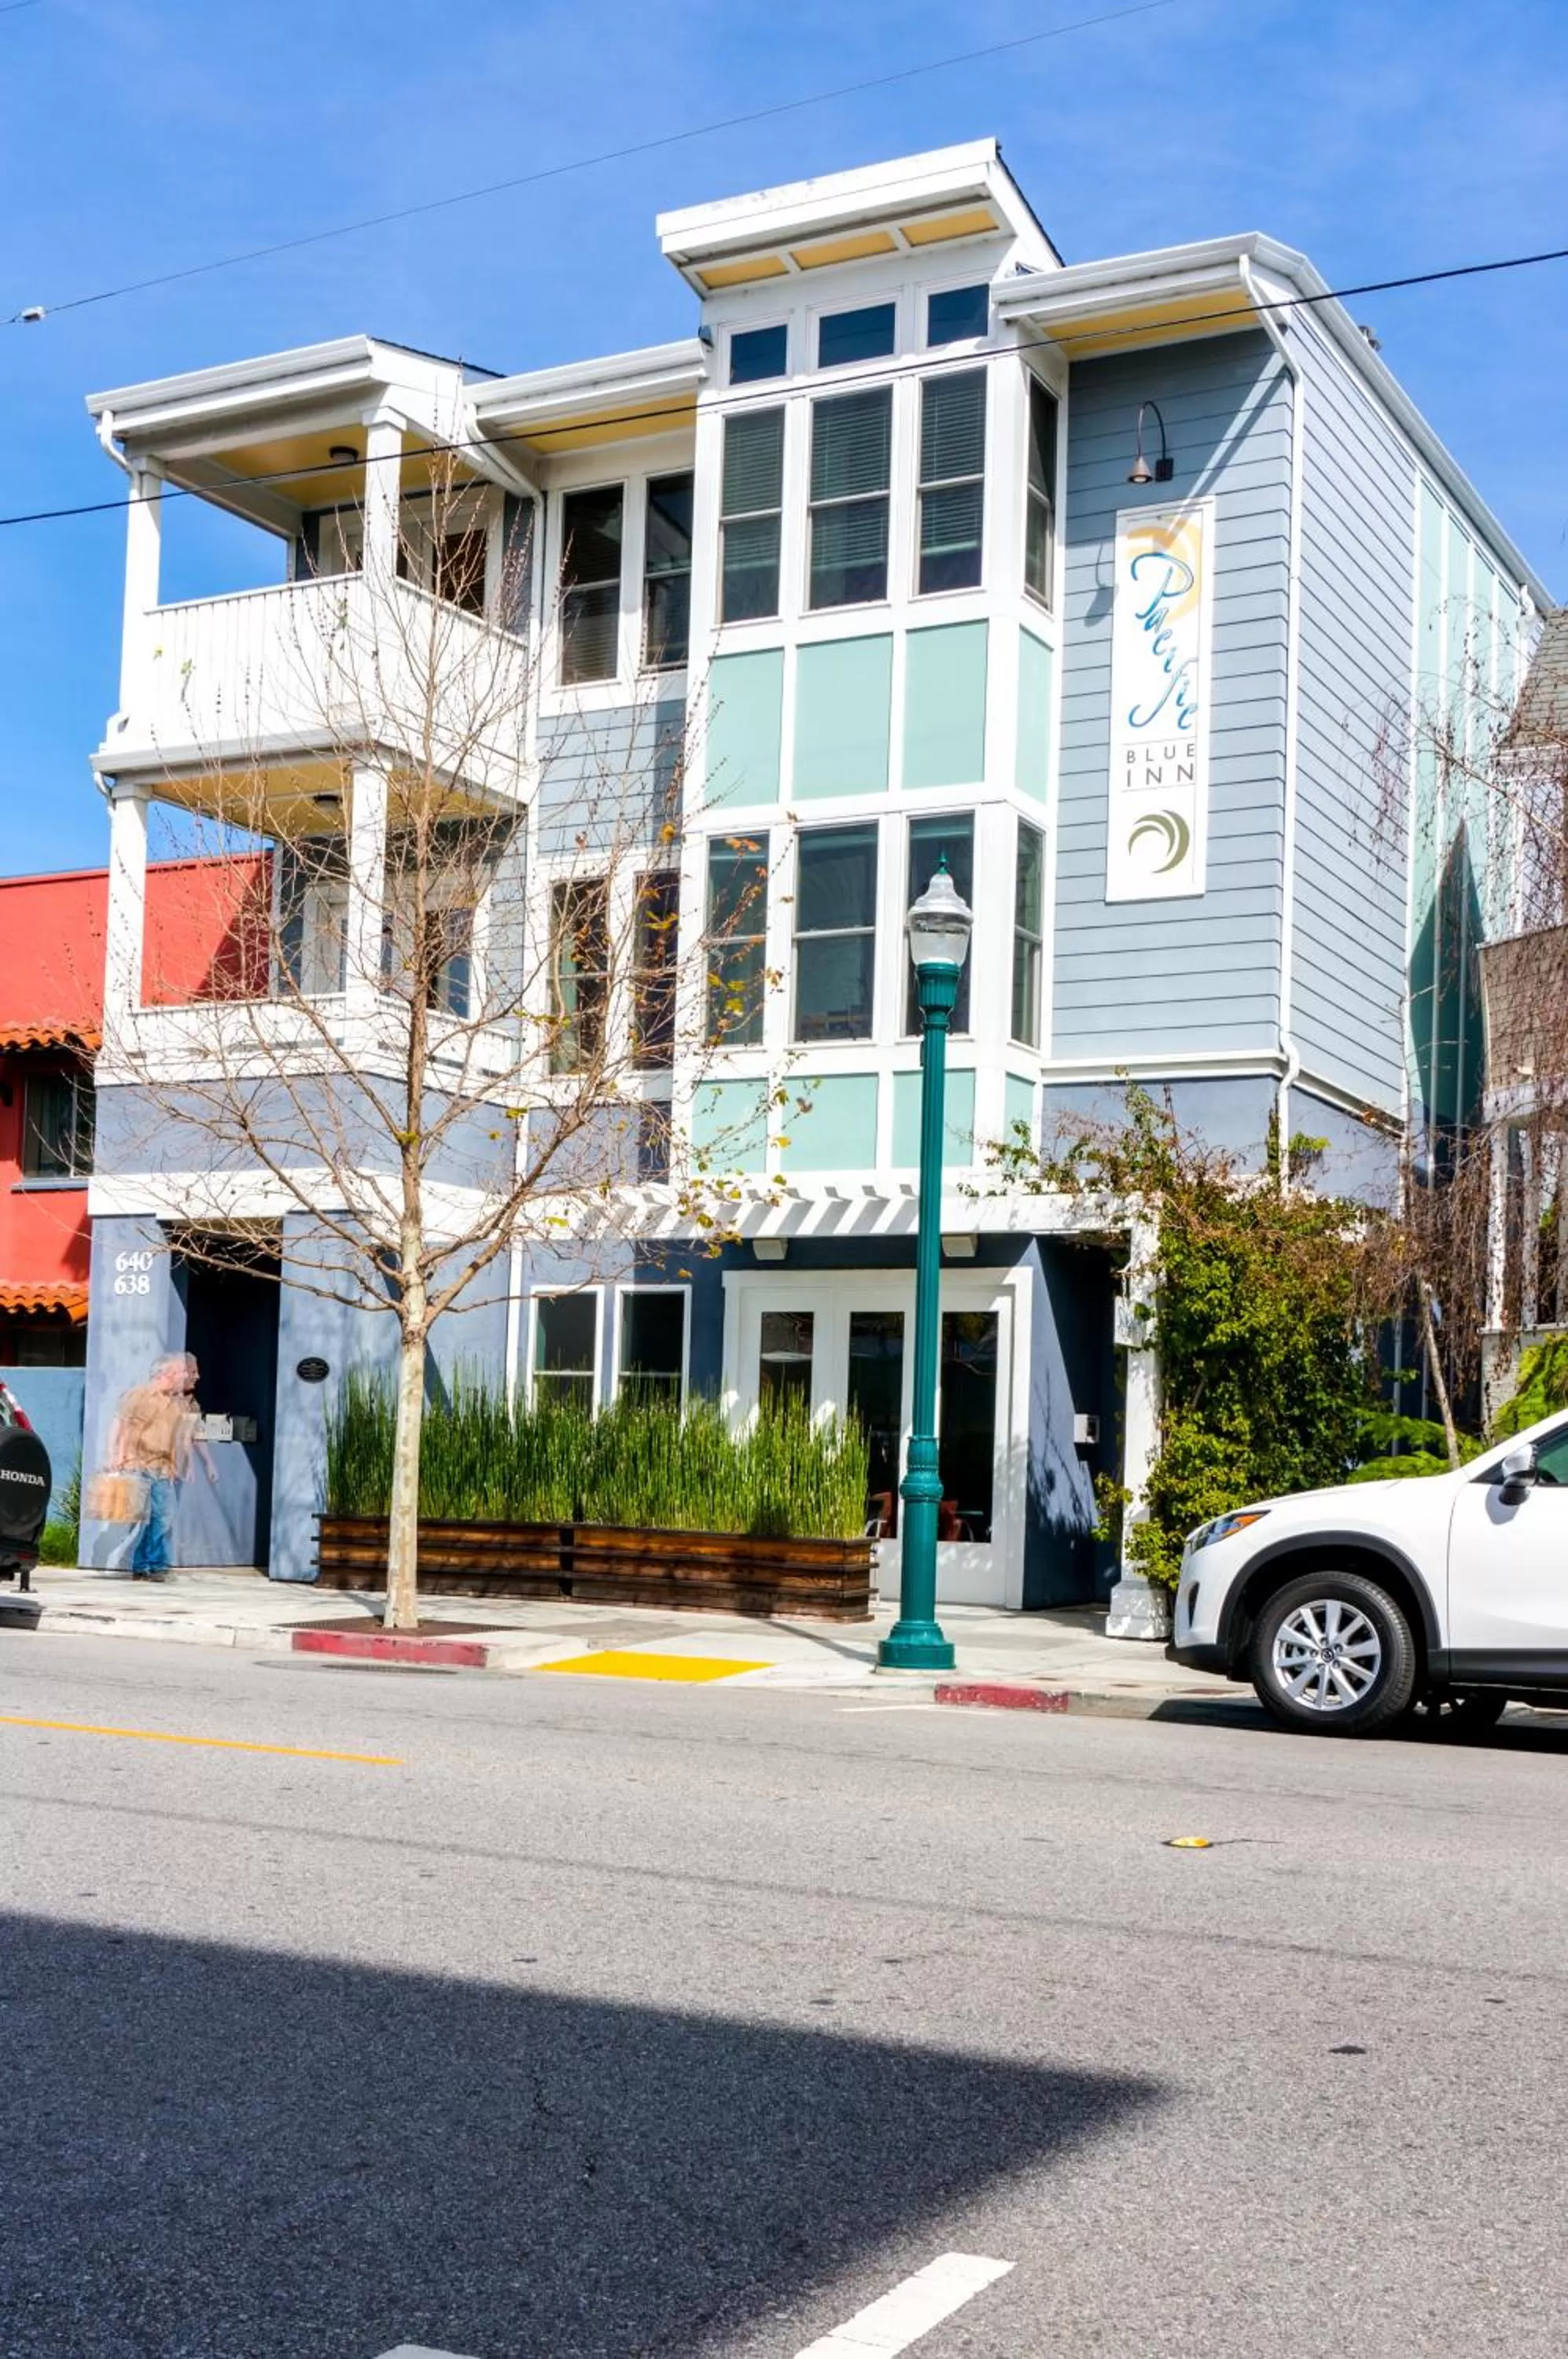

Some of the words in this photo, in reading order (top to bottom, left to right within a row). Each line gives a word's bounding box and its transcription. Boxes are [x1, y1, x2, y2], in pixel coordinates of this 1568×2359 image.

[1128, 552, 1198, 731] Pacific
[1126, 743, 1195, 764] BLUE
[1127, 762, 1194, 787] INN
[115, 1251, 153, 1272] 640
[114, 1275, 150, 1295] 638
[0, 1469, 46, 1487] HONDA
